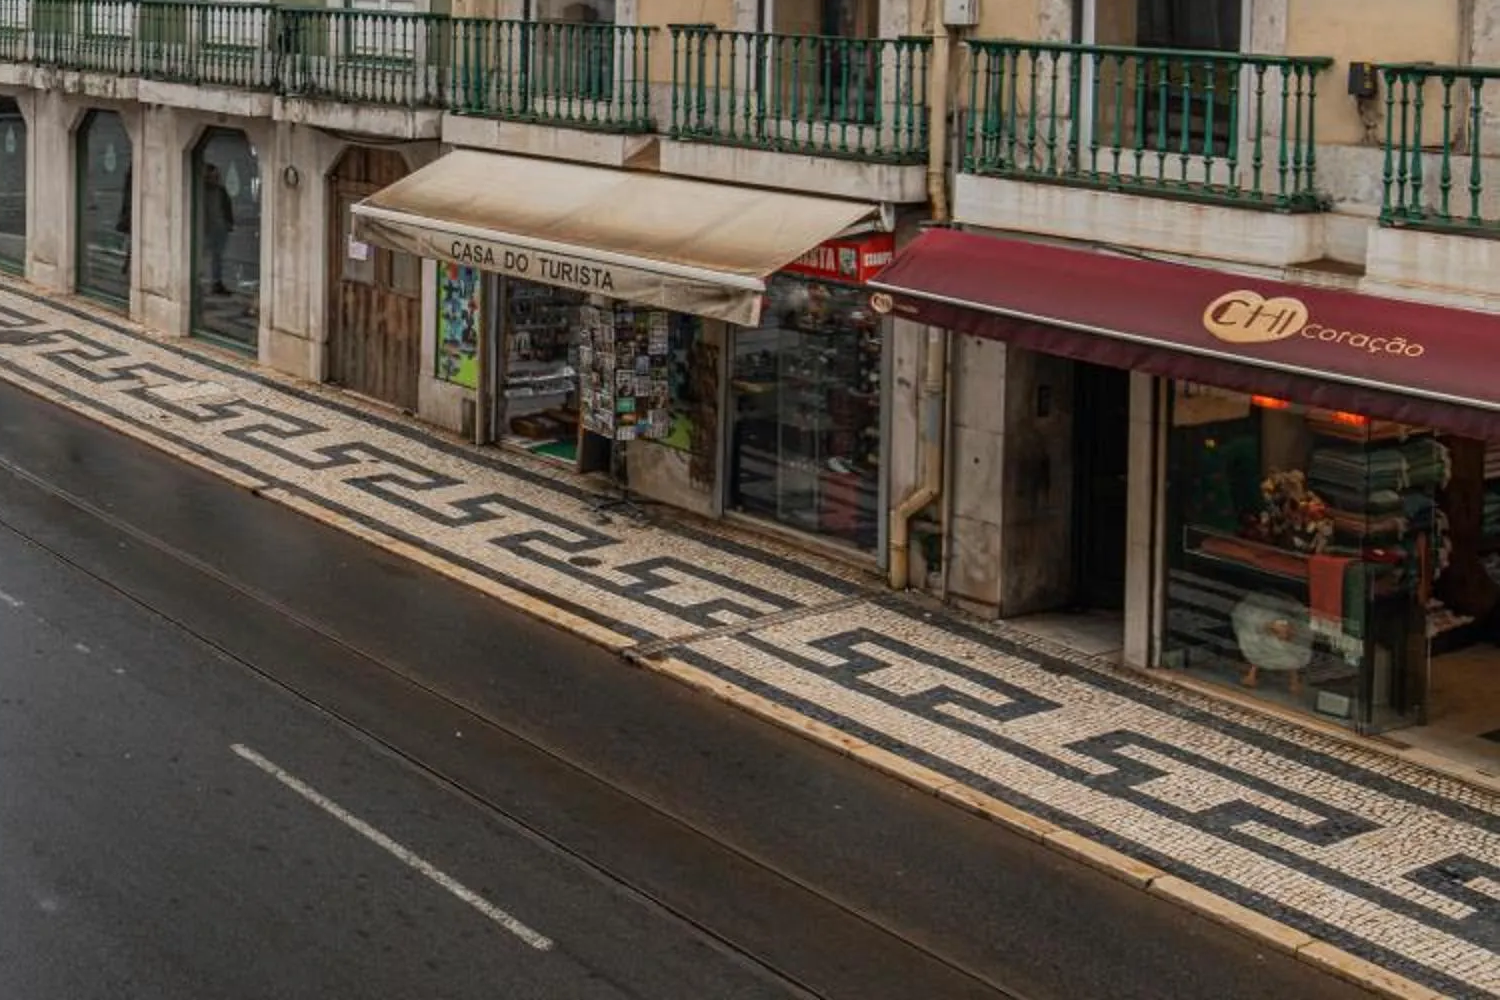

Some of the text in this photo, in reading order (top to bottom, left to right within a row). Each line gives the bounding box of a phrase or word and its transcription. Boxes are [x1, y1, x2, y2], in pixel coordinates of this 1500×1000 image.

[451, 240, 615, 291] CASA DO TURISTA
[1211, 298, 1425, 359] CHI coração
